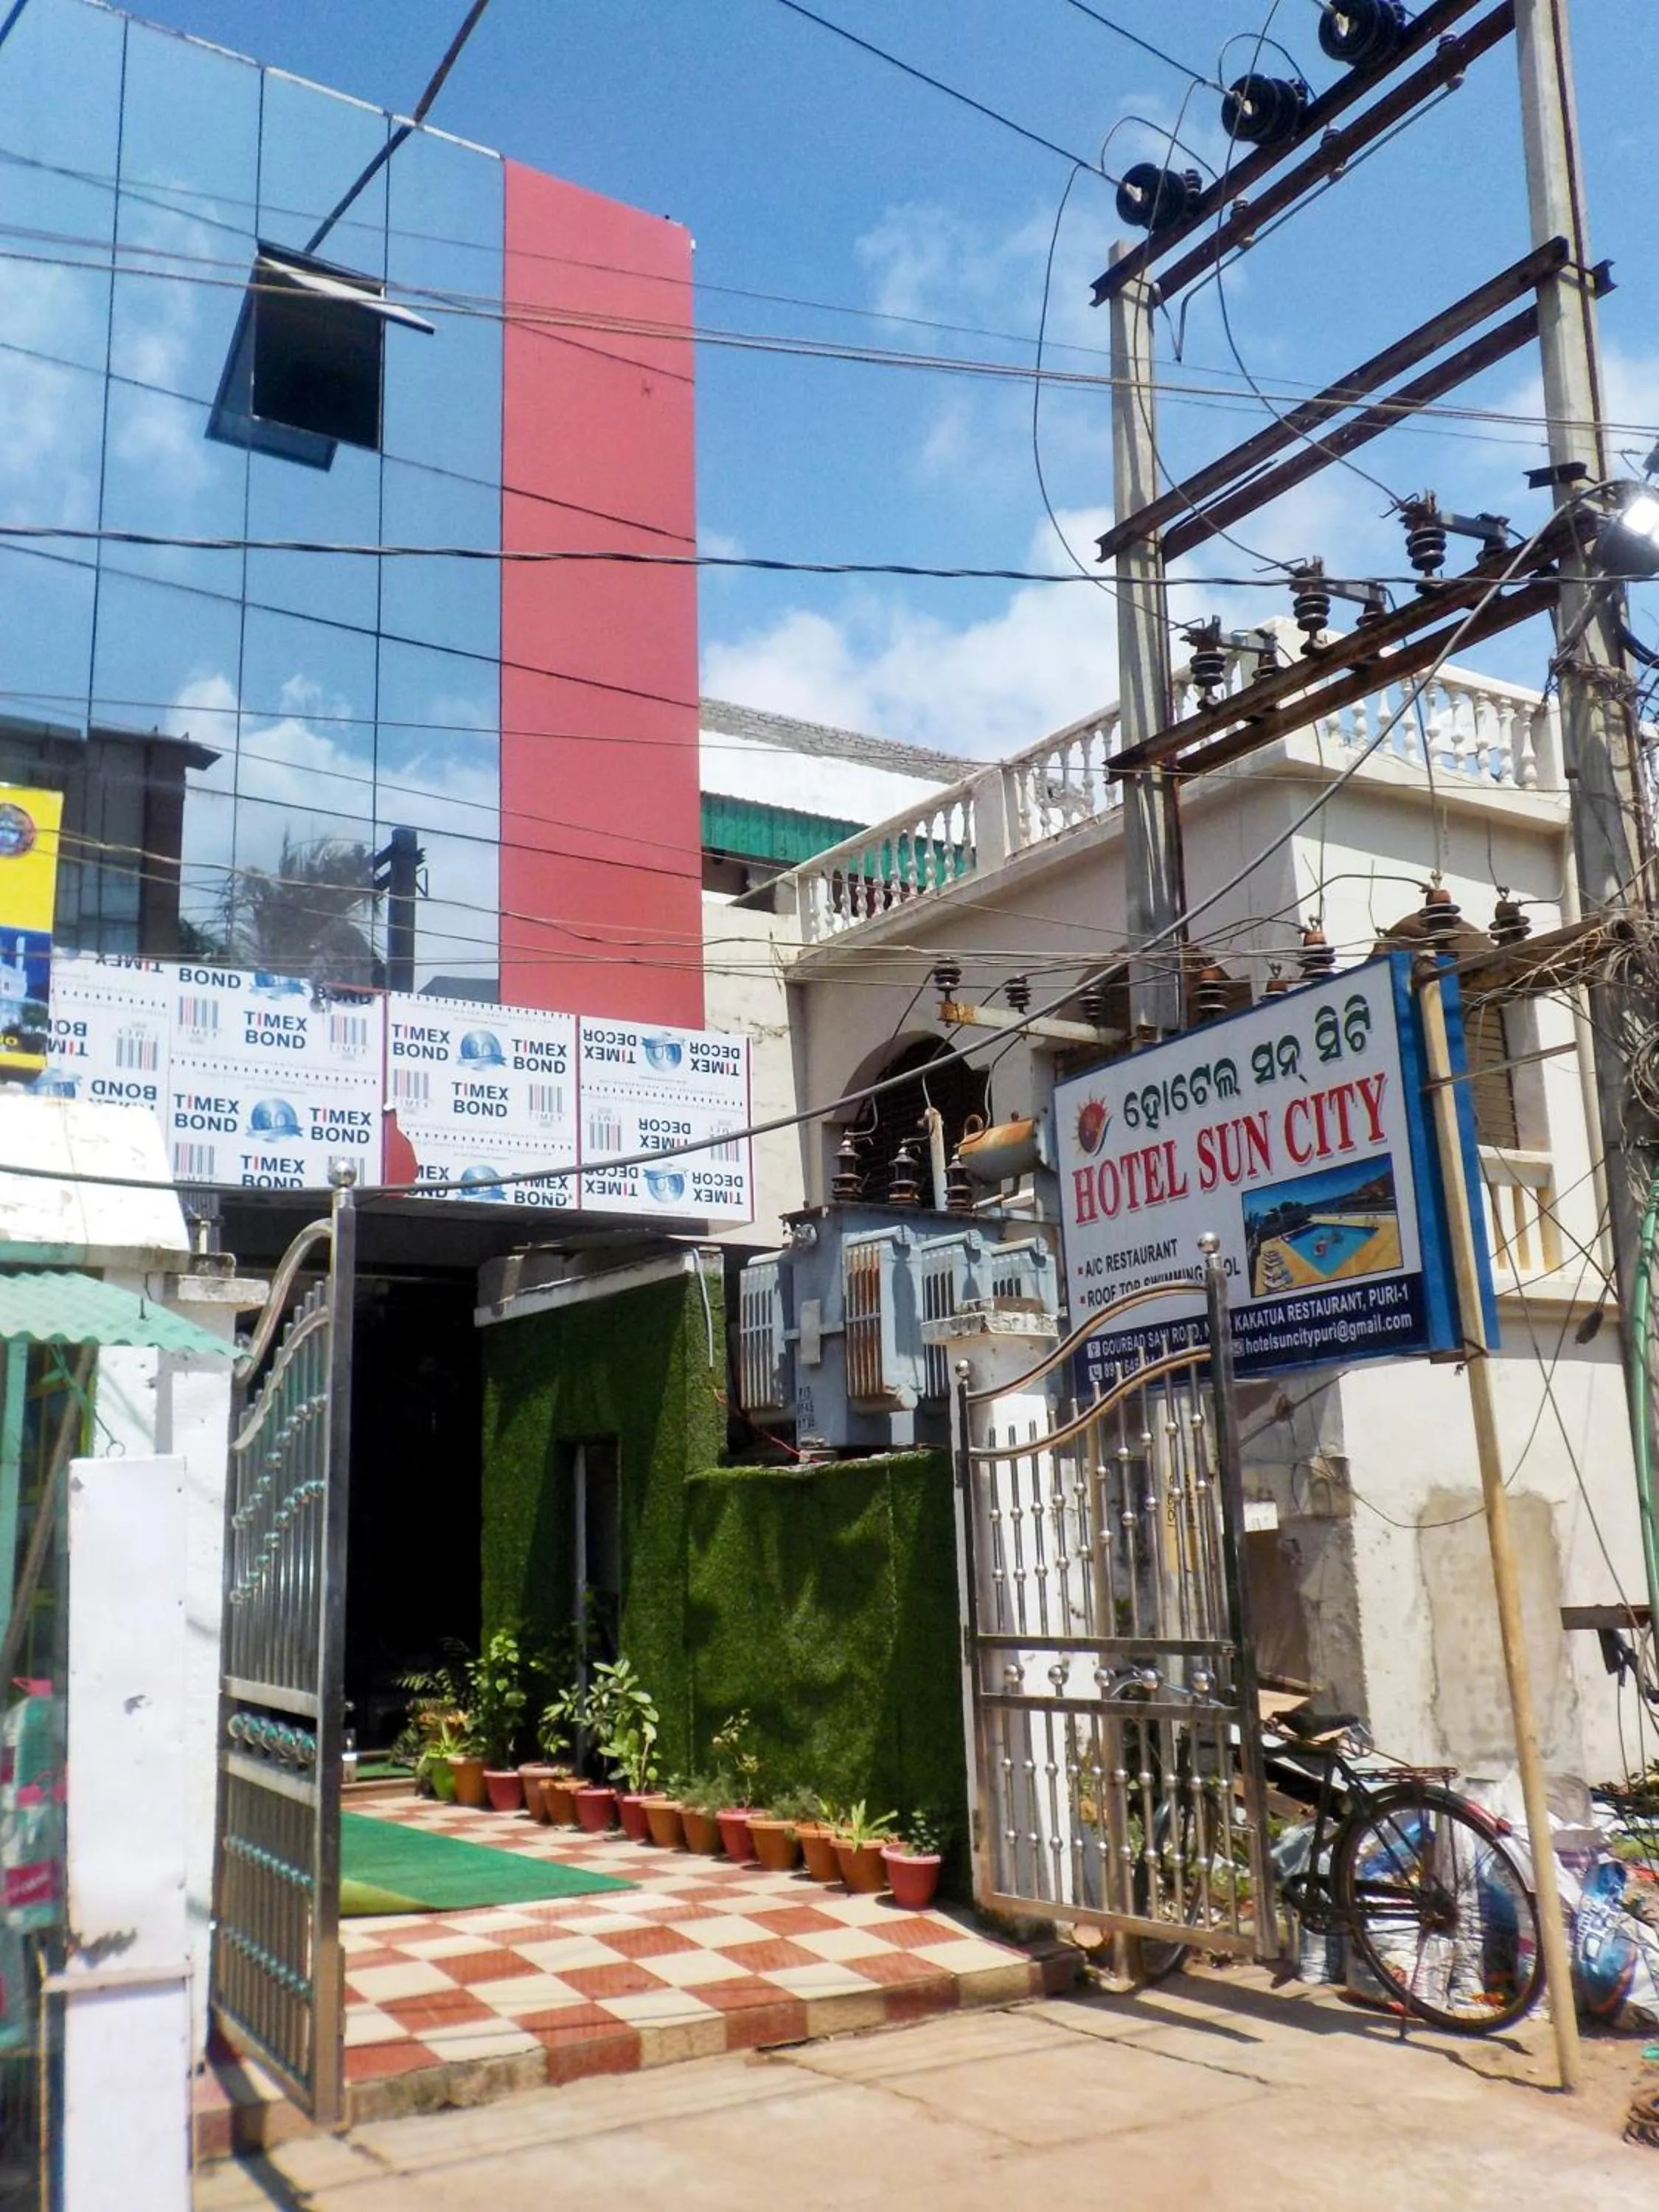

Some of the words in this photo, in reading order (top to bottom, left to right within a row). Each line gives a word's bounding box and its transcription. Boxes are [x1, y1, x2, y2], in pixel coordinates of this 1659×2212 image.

[179, 967, 241, 989] BOND
[243, 1010, 307, 1032] TIMEX
[1315, 994, 1371, 1062] ସିଟି
[246, 1029, 306, 1049] BOND
[392, 1023, 451, 1044] TIMEX
[583, 1029, 636, 1046] DECOR
[47, 1037, 89, 1056] TIM
[393, 1043, 448, 1061] BOND
[512, 1039, 567, 1057] TIMEX
[584, 1046, 636, 1064] TIMEX
[689, 1042, 740, 1059] DECOR
[514, 1057, 566, 1074] BOND
[691, 1058, 740, 1076] TIMEX
[91, 1079, 157, 1100] BOND
[452, 1082, 509, 1100] TIMEX
[173, 1093, 240, 1114] TIMEX
[453, 1100, 507, 1118] BOND
[175, 1113, 237, 1133] BOND
[310, 1107, 372, 1126] TIMEX
[639, 1118, 691, 1134] DECOR
[311, 1127, 371, 1144] BOND
[1072, 1139, 1189, 1225] HOTEL
[1197, 1110, 1273, 1192] SUN
[1284, 1073, 1387, 1166] CITY
[240, 1155, 305, 1175] TIMEX
[243, 1175, 303, 1188] BOND
[585, 1180, 638, 1197] TIMEX
[692, 1172, 743, 1188] DECOR
[515, 1191, 567, 1207] BOND
[694, 1189, 743, 1205] TIMEX
[1085, 1258, 1103, 1277] A/C
[1106, 1239, 1178, 1270] RESTAURANT
[1088, 1285, 1116, 1308] ROOF
[1120, 1276, 1141, 1295] TOP
[1172, 1324, 1203, 1343] ROD,
[1234, 1307, 1285, 1331] KAKATUA
[1288, 1292, 1366, 1321] RESTAURANT,
[1369, 1283, 1408, 1306] PURI-1
[1246, 1313, 1412, 1354] hotelsuncitypuri@gmail.com
